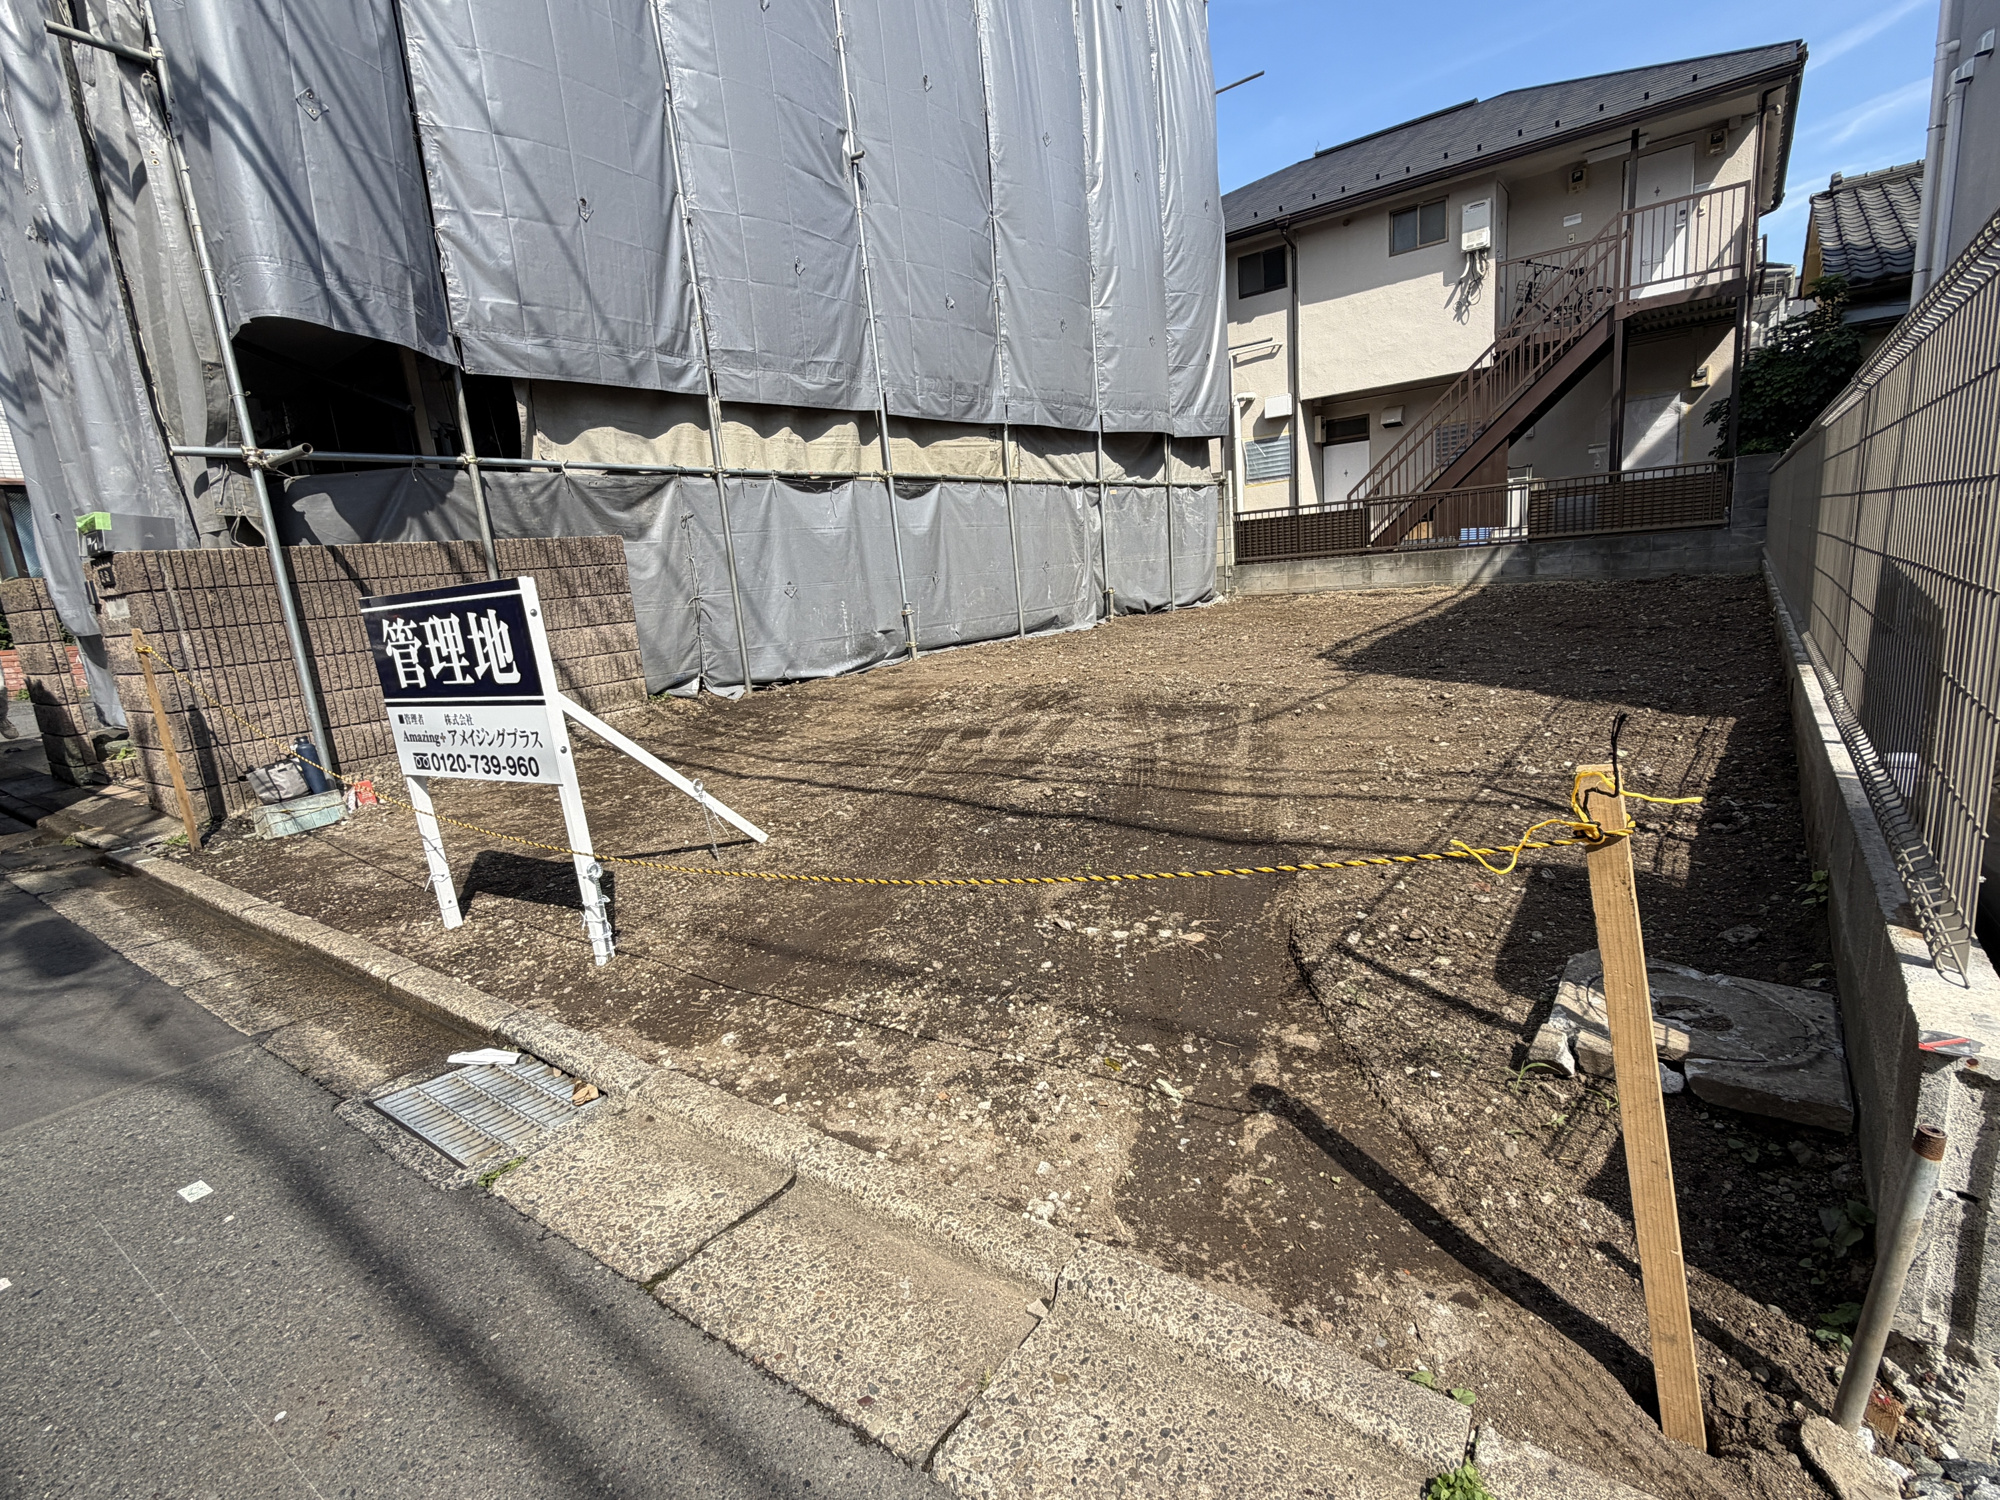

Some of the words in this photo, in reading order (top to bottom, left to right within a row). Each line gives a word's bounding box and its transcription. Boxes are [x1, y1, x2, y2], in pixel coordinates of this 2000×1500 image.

[382, 609, 521, 688] 管理地
[444, 713, 474, 726] 株式会社
[447, 727, 543, 748] アメイジングプラス
[431, 752, 540, 777] 0120-739-960
